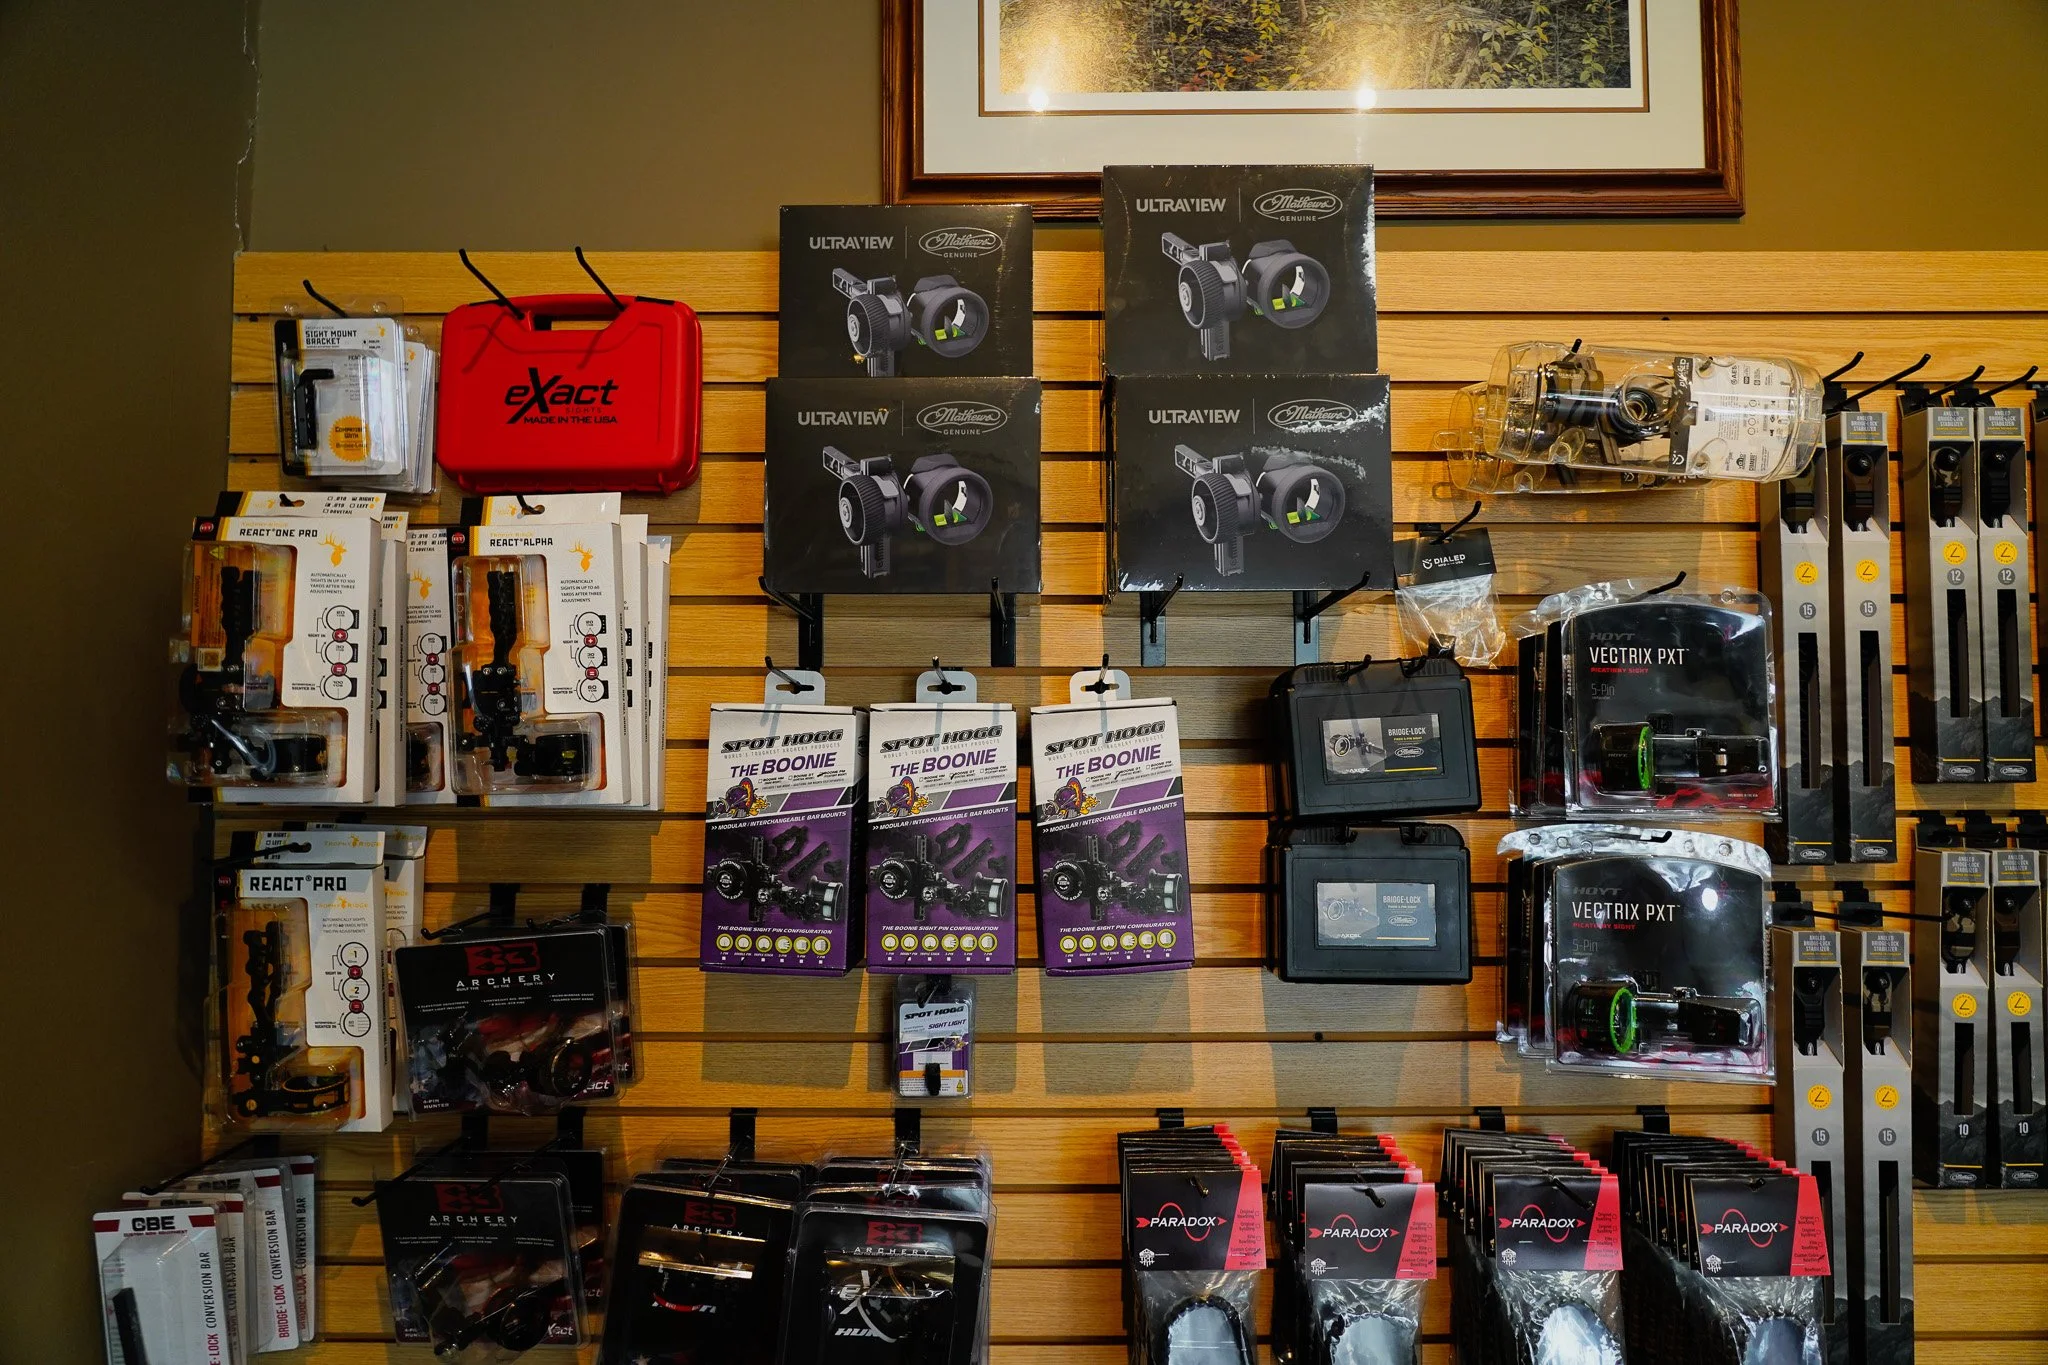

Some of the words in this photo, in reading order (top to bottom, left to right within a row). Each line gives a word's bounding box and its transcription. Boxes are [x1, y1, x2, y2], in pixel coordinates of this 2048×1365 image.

[1136, 198, 1226, 212] ULTRAVIEW
[1260, 194, 1336, 213] Mathews
[809, 236, 894, 250] ULTRAVIEW
[926, 232, 996, 250] Mathews
[505, 367, 619, 424] eXact
[524, 416, 555, 424] MADE
[558, 416, 569, 424] IN
[571, 416, 592, 424] THE
[797, 411, 889, 426] ULTRAVIEW
[924, 407, 1001, 427] Mathews
[1149, 409, 1240, 424] ULTRAVIEW
[1275, 405, 1351, 425] Mathews
[299, 529, 318, 537] PRO
[1434, 554, 1466, 564] DIALED
[1951, 571, 1961, 581] 12
[2001, 570, 2012, 581] 12
[1803, 605, 1812, 615] 15
[1864, 603, 1873, 613] 15
[1590, 632, 1635, 641] HOYT
[1590, 647, 1652, 665] VECTRIX
[880, 734, 940, 753] SPOT
[941, 725, 1003, 744] HOGG
[1044, 733, 1103, 757] SPOT
[1105, 720, 1165, 743] HOGG
[1388, 728, 1426, 736] BRIDGE-LOCK
[721, 736, 780, 754] SPOT
[782, 729, 843, 747] HOGG
[731, 764, 760, 778] THE
[761, 752, 837, 774] BOONIE
[891, 762, 920, 777] THE
[922, 748, 997, 773] BOONIE
[1056, 762, 1085, 780] THE
[1087, 744, 1161, 773] BOONIE
[718, 822, 746, 830] MODULAR
[750, 816, 805, 827] INTERCHANGEABLE
[821, 811, 847, 819] MOUNTS
[880, 821, 909, 830] MODULAR
[913, 813, 968, 825] INTERCHANGEABLE
[983, 807, 1008, 815] MOUNTS
[1050, 823, 1079, 833] MODULAR
[1082, 809, 1137, 826] INTERCHANGEABLE
[1152, 801, 1178, 811] MOUNTS
[1572, 902, 1640, 920] VECTRIX
[456, 973, 555, 988] ARCHERY
[904, 1010, 934, 1020] SPOT
[935, 1006, 964, 1015] HOGG
[1958, 1124, 1969, 1135] 10
[2018, 1122, 2028, 1133] 10
[1816, 1130, 1826, 1142] 15
[1883, 1130, 1893, 1142] 15
[296, 1197, 306, 1217] BAR
[131, 1216, 175, 1232] CBE
[265, 1209, 276, 1233] BAR
[430, 1215, 518, 1223] ARCHERY
[1150, 1216, 1216, 1227] PARADOX
[1512, 1218, 1576, 1228] PARADOX
[672, 1223, 743, 1237] ARCHERY
[1323, 1228, 1389, 1238] PARADOX
[1714, 1222, 1778, 1233] PARADOX
[295, 1218, 306, 1269] CONVERSION
[854, 1247, 931, 1255] ARCHERY
[200, 1251, 210, 1275] BAR
[266, 1234, 283, 1280] CONVERSION
[200, 1276, 217, 1328] CONVERSION
